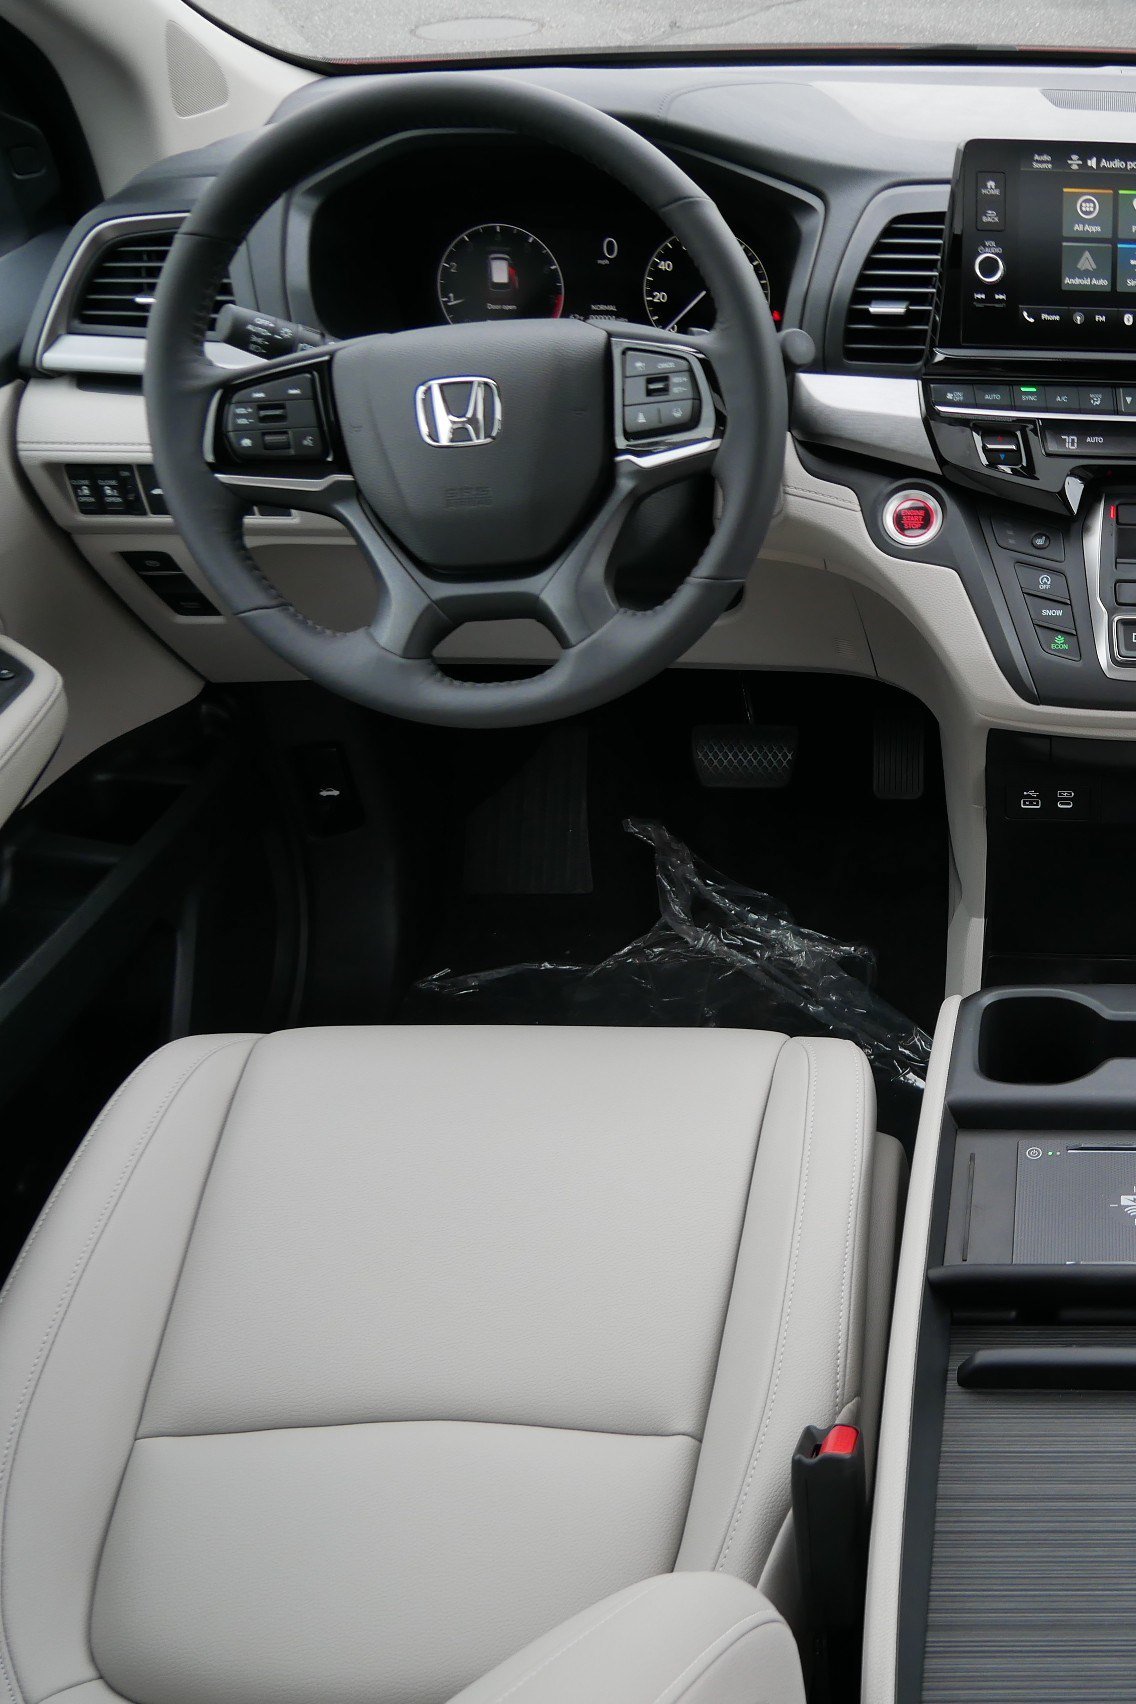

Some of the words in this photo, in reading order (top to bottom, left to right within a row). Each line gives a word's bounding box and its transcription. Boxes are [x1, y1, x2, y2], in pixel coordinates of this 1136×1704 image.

[1034, 154, 1051, 162] Audio
[1100, 158, 1126, 169] Audio
[1074, 224, 1084, 232] All
[1084, 224, 1101, 233] Apps
[603, 237, 618, 259] 0
[450, 262, 458, 273] 2
[658, 260, 673, 272] 40
[1064, 277, 1091, 286] Android
[1091, 278, 1109, 286] Auto
[652, 291, 668, 303] 20
[591, 304, 617, 312] NORMAL
[1041, 313, 1061, 321] Phone
[984, 393, 1001, 401] AUTO
[1061, 435, 1078, 450] 70
[1086, 436, 1104, 444] AUTO
[1041, 609, 1063, 617] SNOW
